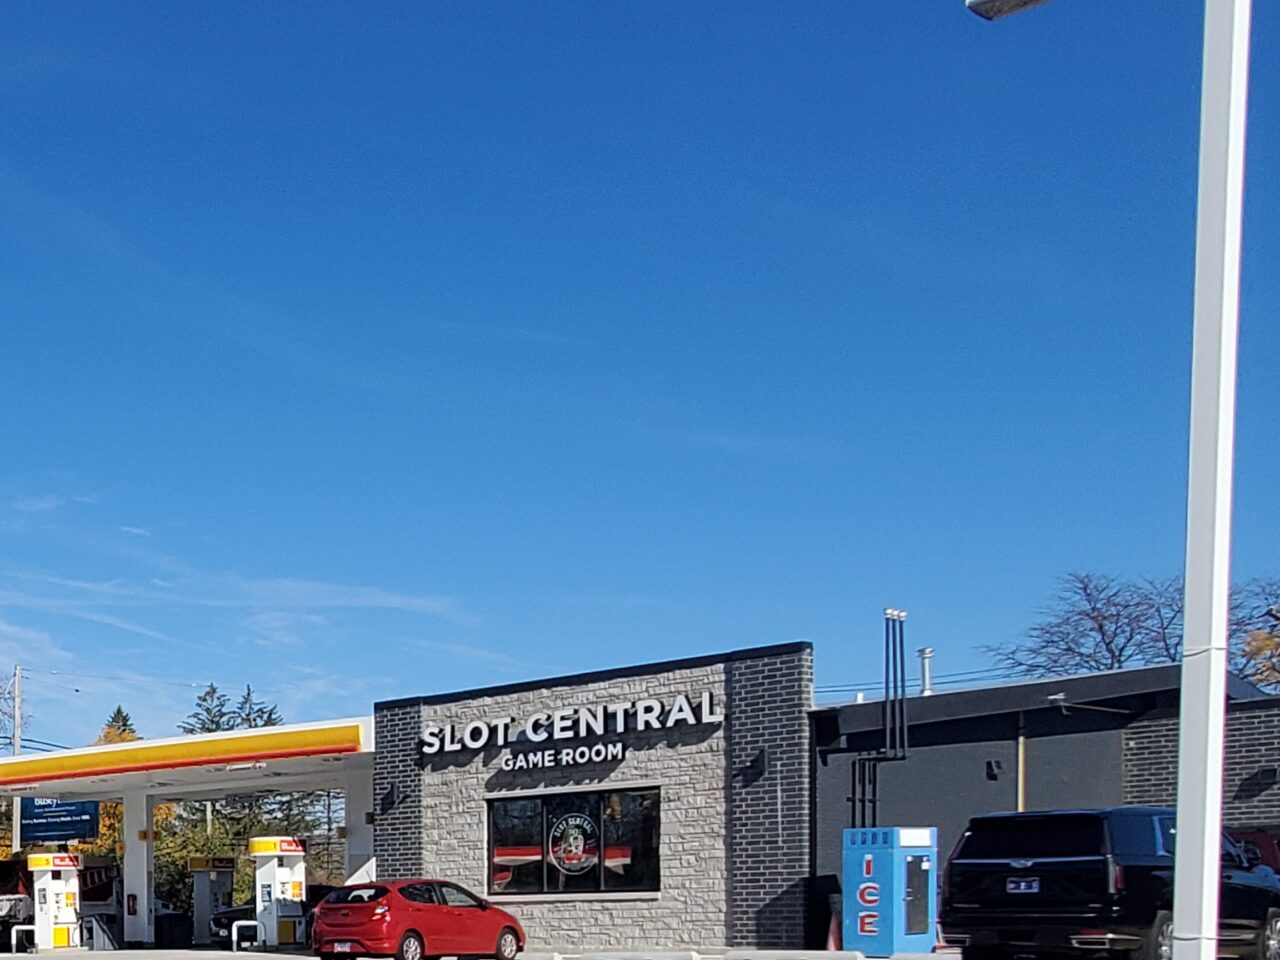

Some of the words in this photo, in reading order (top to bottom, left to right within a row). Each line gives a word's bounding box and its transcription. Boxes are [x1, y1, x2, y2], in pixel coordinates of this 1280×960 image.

[422, 717, 512, 755] SLOT
[526, 691, 725, 743] CENTRAL
[501, 752, 556, 772] GAME
[561, 742, 623, 765] ROOM
[857, 854, 881, 937] ICE
